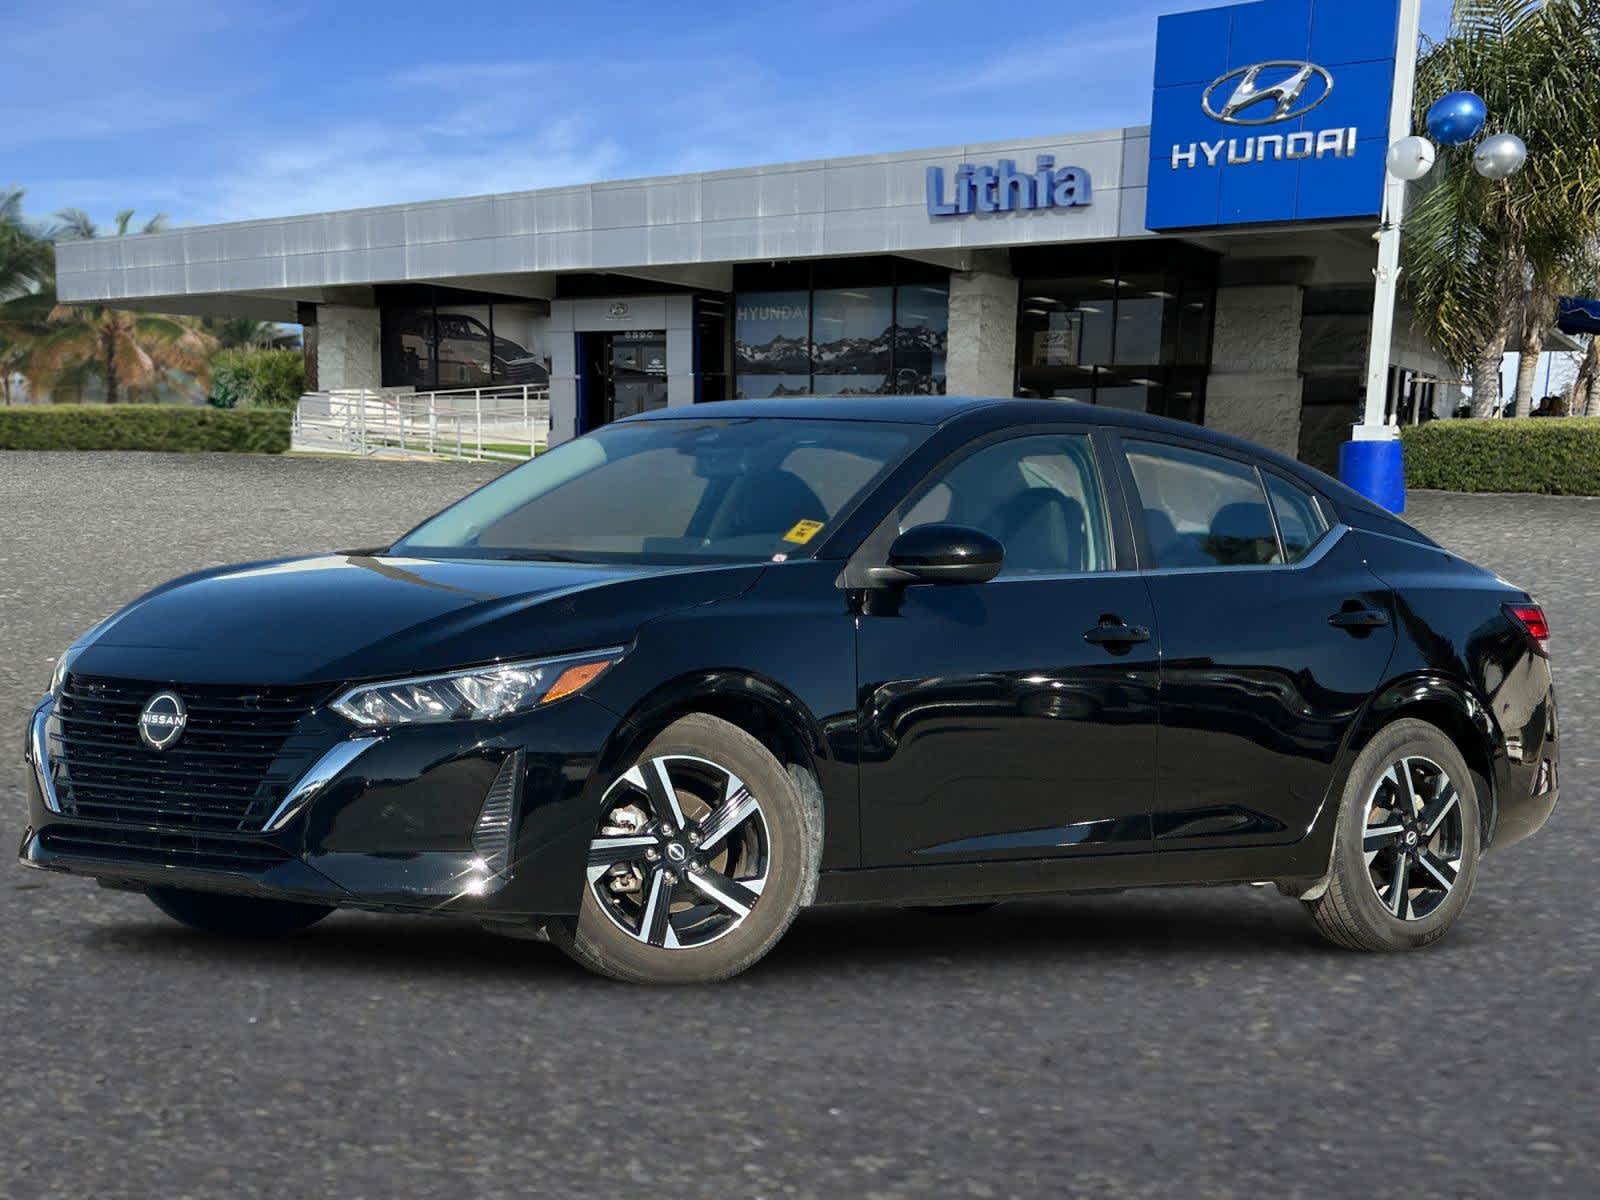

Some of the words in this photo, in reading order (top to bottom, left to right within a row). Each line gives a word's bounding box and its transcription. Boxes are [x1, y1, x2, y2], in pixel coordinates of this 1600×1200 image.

[1171, 127, 1357, 169] HYUNDAI
[926, 154, 1093, 215] Lithia
[736, 304, 809, 321] HYUNDAI
[141, 713, 184, 727] NISSAN
